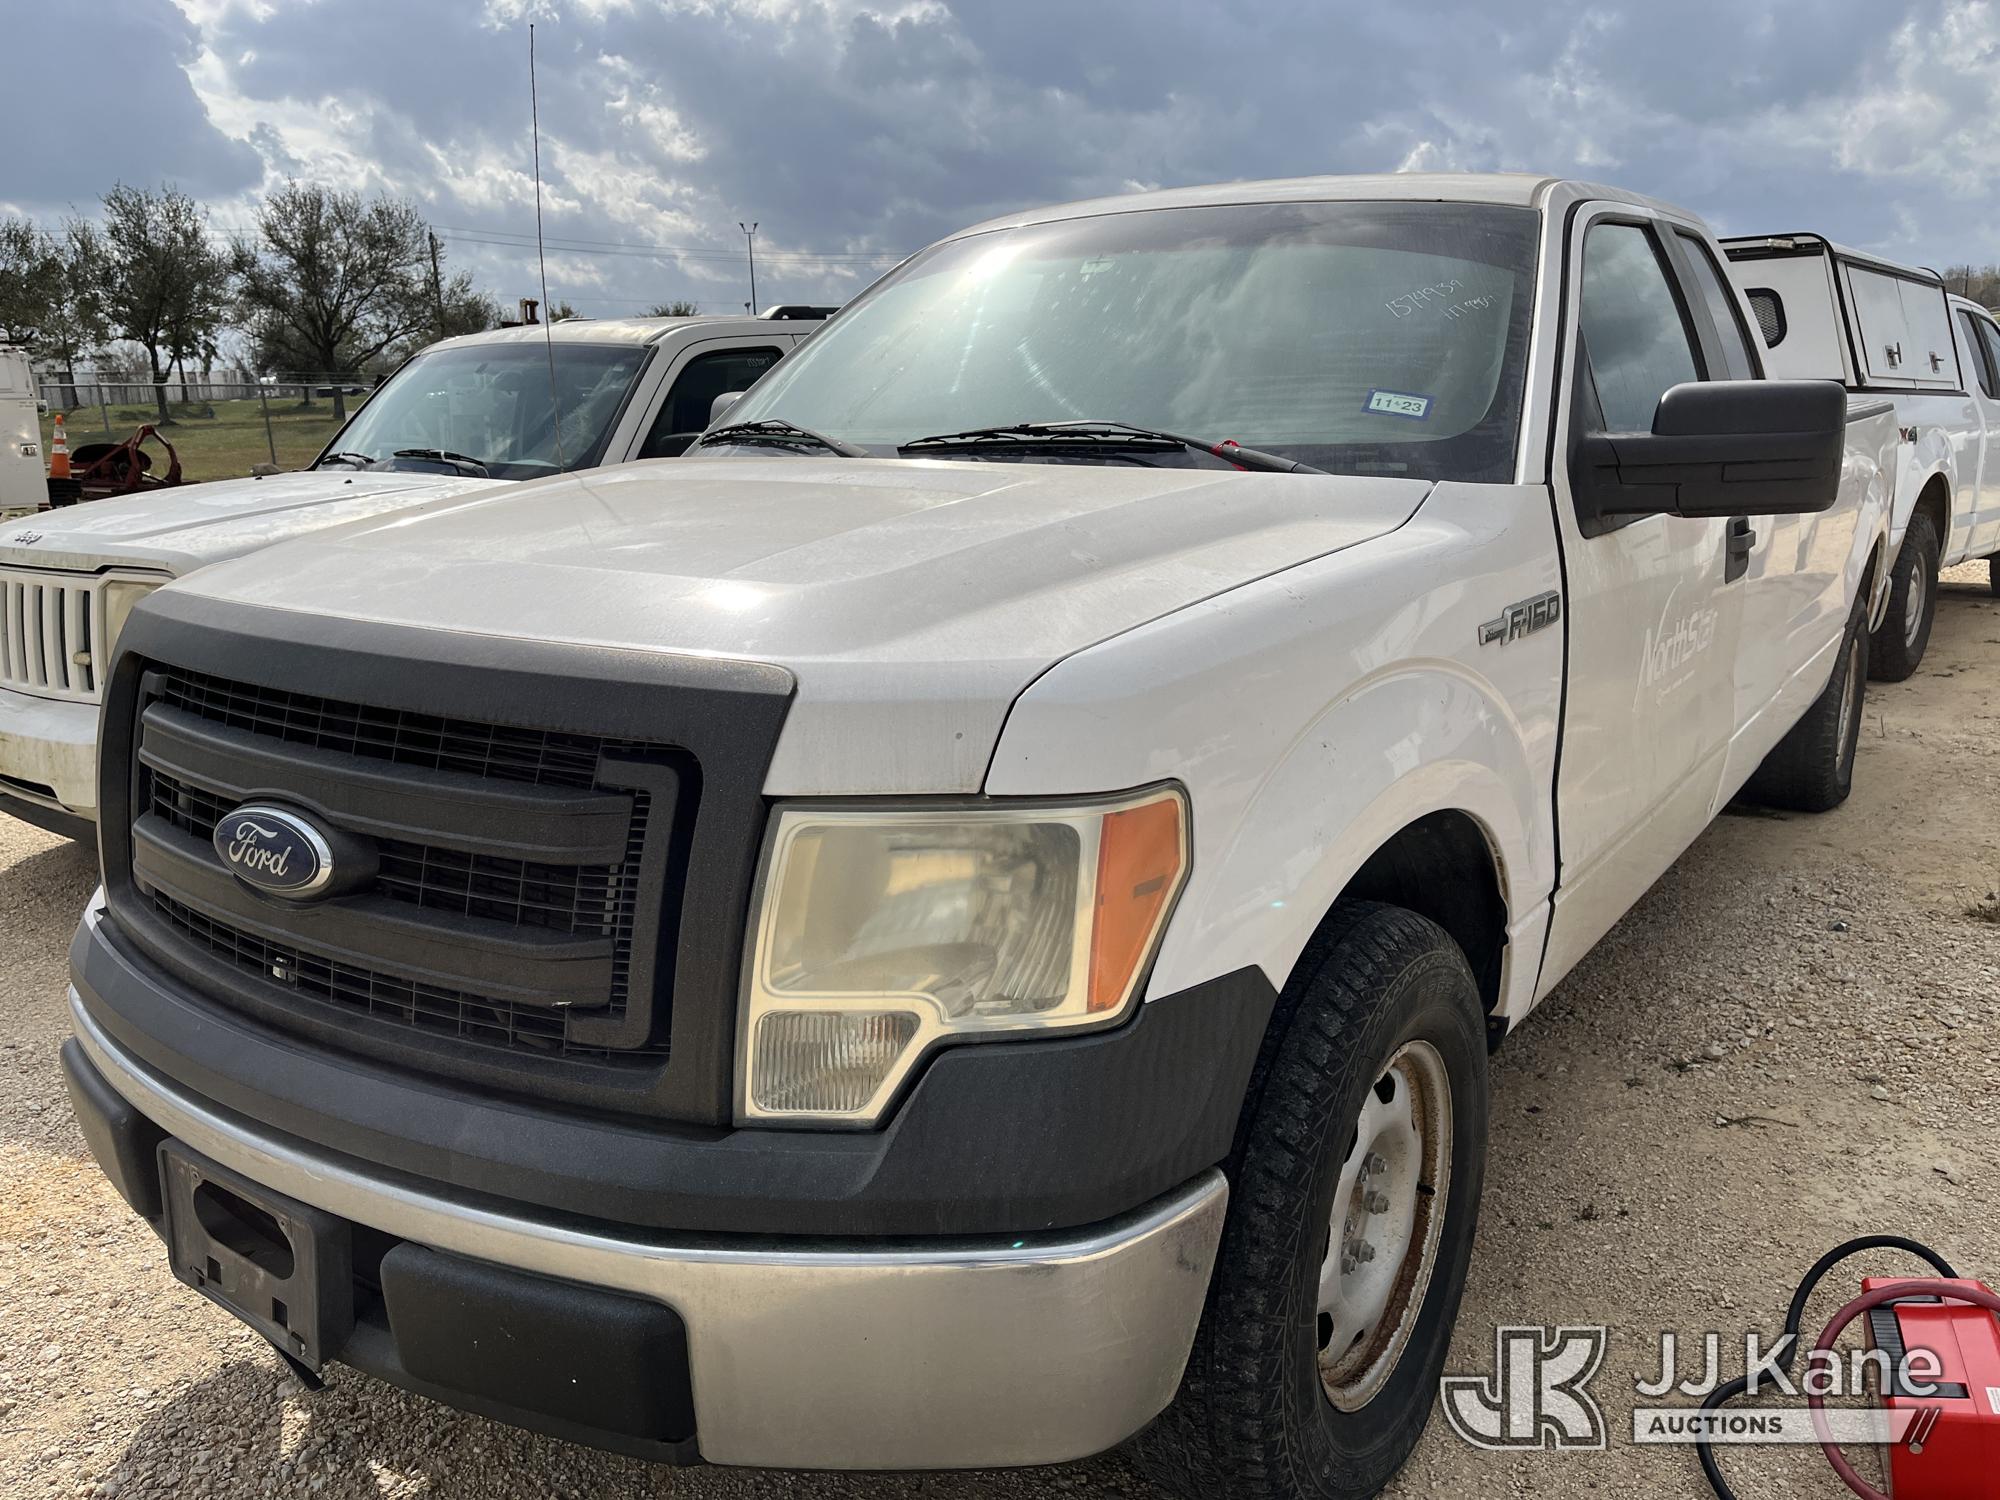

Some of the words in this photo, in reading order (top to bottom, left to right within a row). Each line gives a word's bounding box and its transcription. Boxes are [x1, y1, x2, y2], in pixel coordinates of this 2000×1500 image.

[1384, 279, 1464, 318] 1574939
[1375, 398, 1393, 408] 11
[1401, 401, 1422, 412] 23
[1898, 426, 1918, 445] X4
[228, 821, 293, 877] Ford
